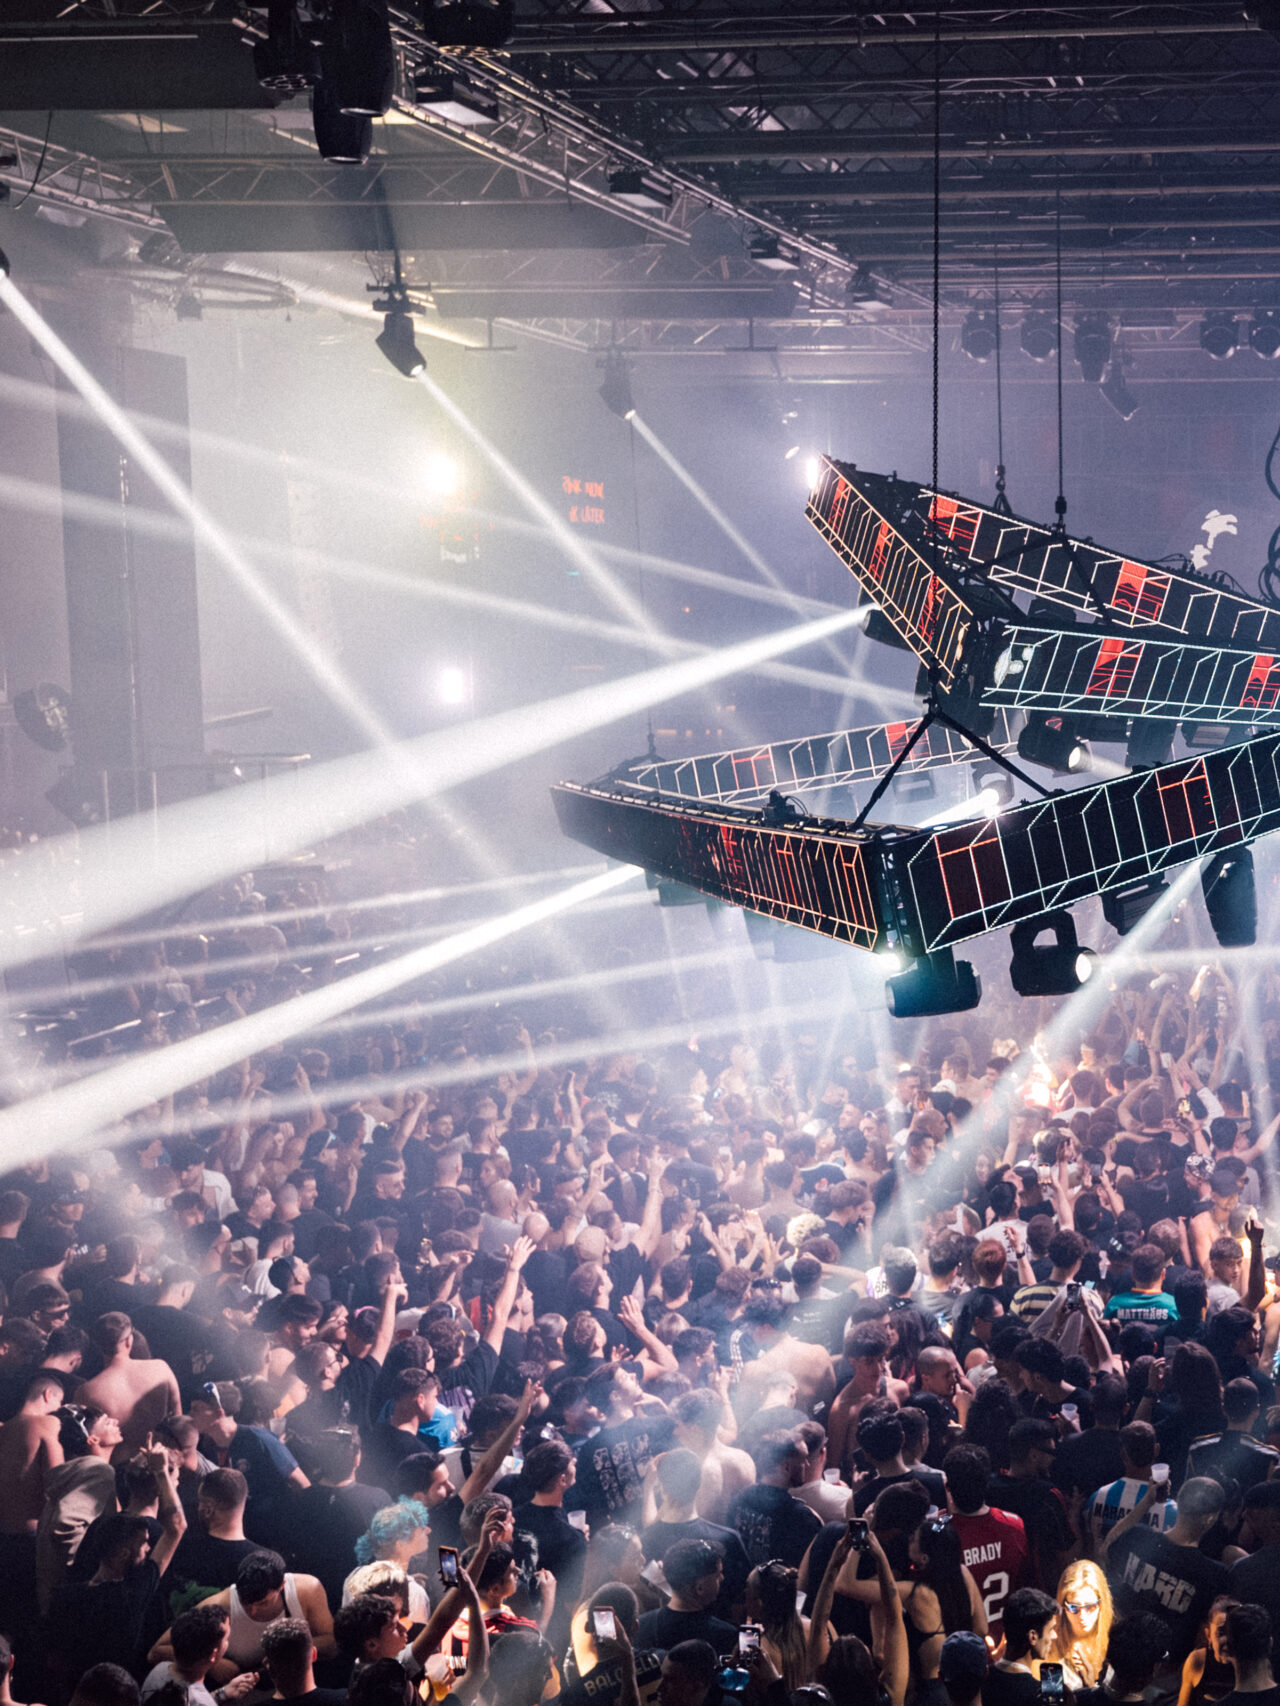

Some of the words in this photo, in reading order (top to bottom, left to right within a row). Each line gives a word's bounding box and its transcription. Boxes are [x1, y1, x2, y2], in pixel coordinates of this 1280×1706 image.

[1117, 1306, 1168, 1320] MATTHÄUS
[1093, 1502, 1159, 1528] MARANA
[963, 1541, 1002, 1567] BRADY
